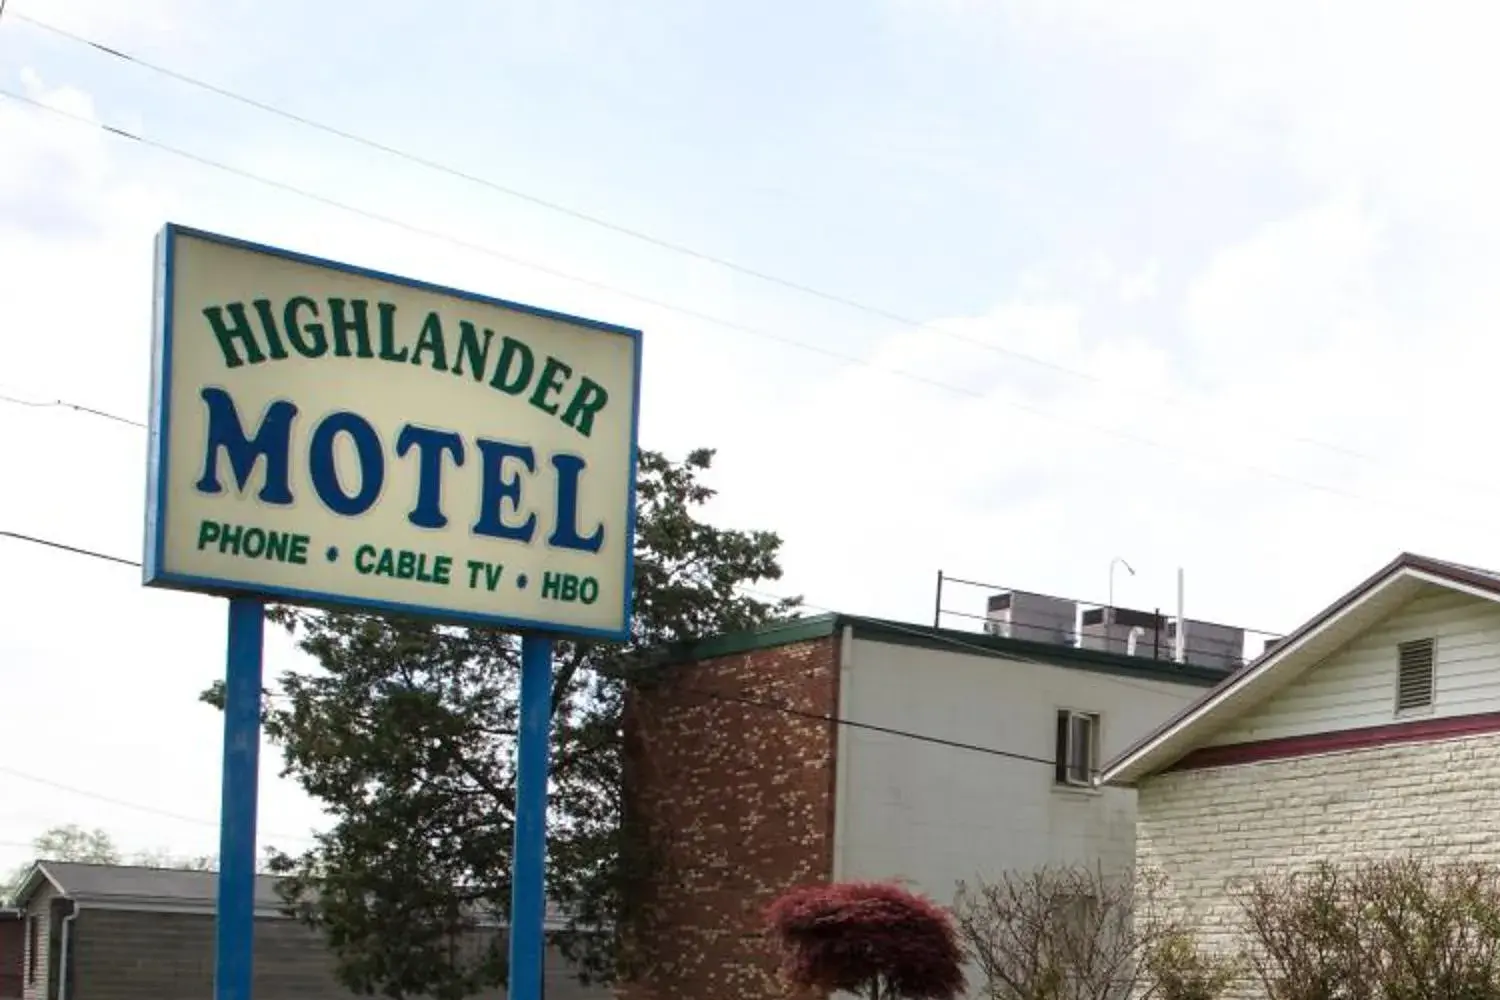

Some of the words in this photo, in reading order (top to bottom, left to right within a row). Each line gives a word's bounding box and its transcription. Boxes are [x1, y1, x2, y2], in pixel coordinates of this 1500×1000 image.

[202, 295, 610, 438] HIGHLANDER
[196, 386, 604, 554] MOTEL
[197, 520, 311, 566] PHONE
[355, 544, 453, 585] CABLE
[466, 560, 504, 592] TV
[541, 571, 599, 605] HBO
